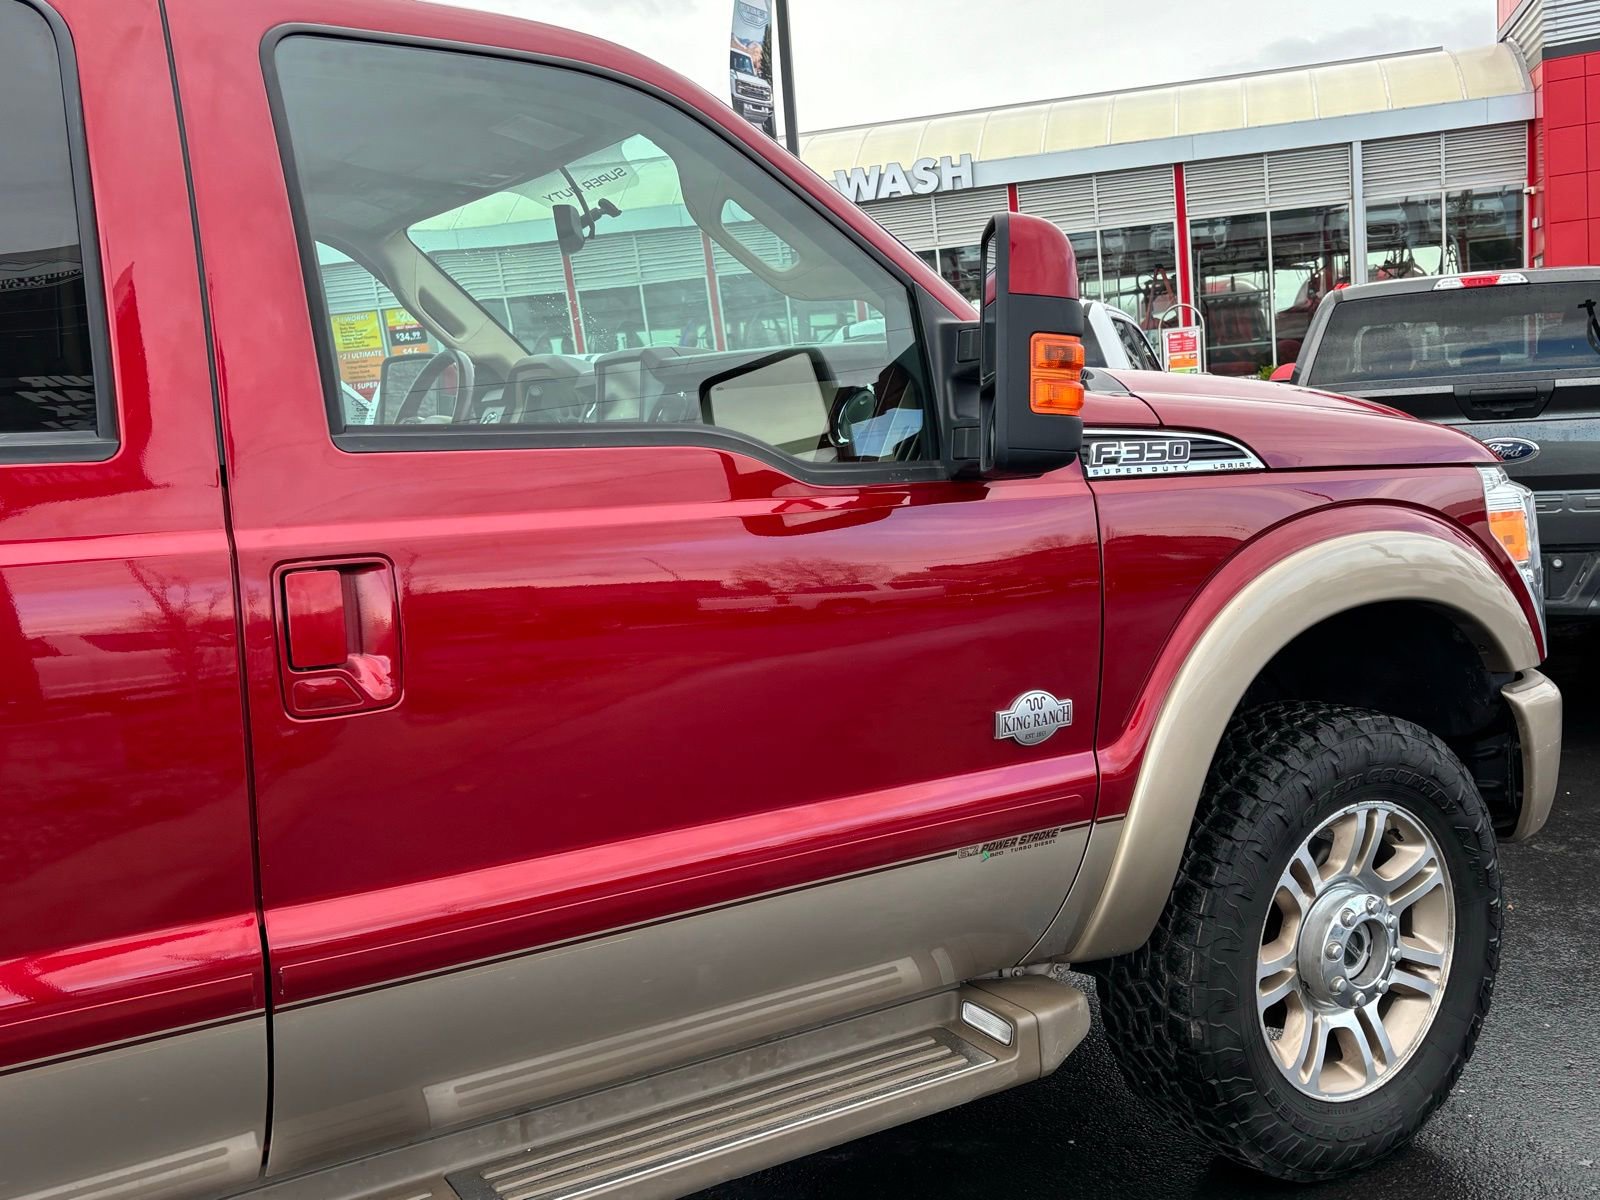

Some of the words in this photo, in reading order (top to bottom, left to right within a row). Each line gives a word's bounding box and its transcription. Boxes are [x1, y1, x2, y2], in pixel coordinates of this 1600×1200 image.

[833, 153, 974, 201] WASH
[351, 350, 382, 360] ULTIMATE
[1090, 440, 1191, 467] F-350
[1488, 442, 1523, 457] Ford
[1093, 467, 1143, 476] SUPER
[1213, 461, 1252, 470] LARIAT
[1003, 714, 1031, 733] KING
[1033, 704, 1070, 728] RANCH
[980, 837, 1019, 854] POWER
[1018, 828, 1060, 845] STROKE
[1010, 844, 1032, 853] TURBO
[1034, 839, 1056, 848] DIESEL
